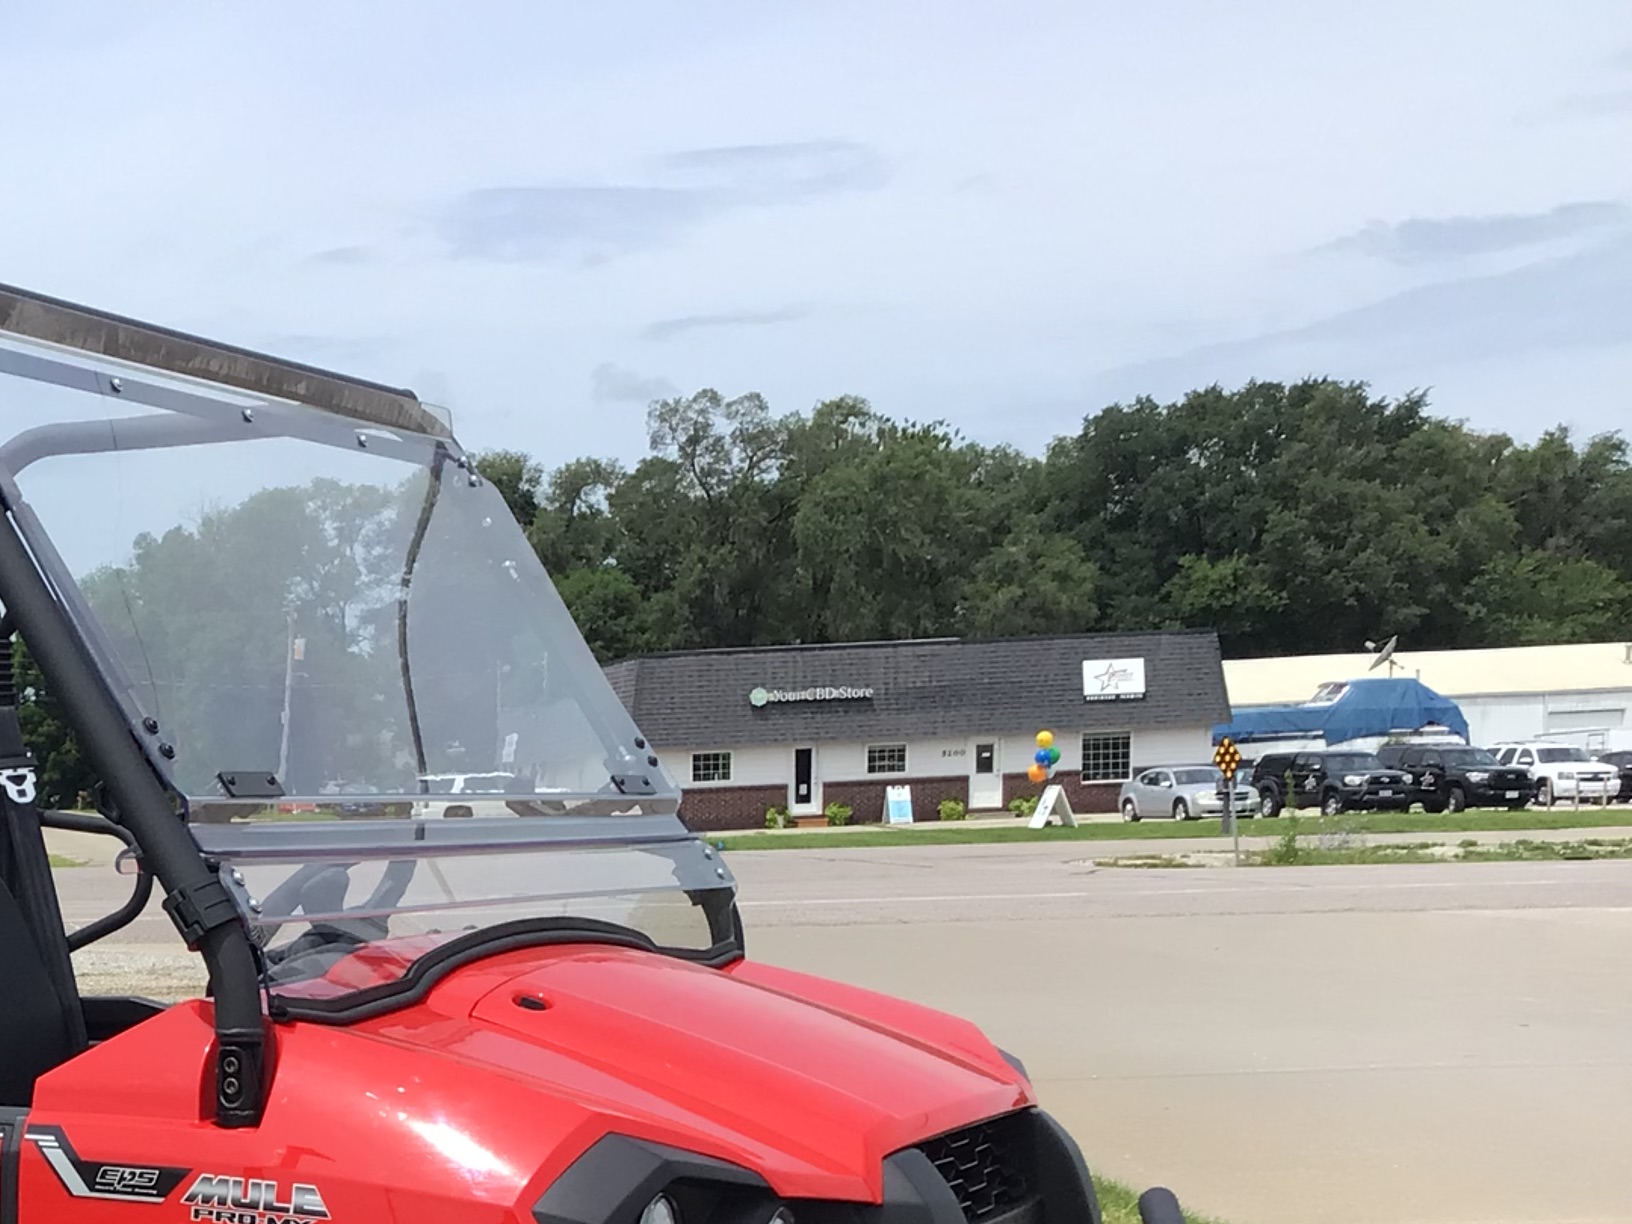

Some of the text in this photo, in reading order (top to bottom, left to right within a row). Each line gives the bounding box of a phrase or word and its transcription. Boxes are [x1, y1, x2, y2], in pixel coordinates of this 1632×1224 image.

[773, 686, 874, 702] Your CBD Store
[95, 1166, 160, 1187] EPS
[180, 1173, 332, 1220] MULE
